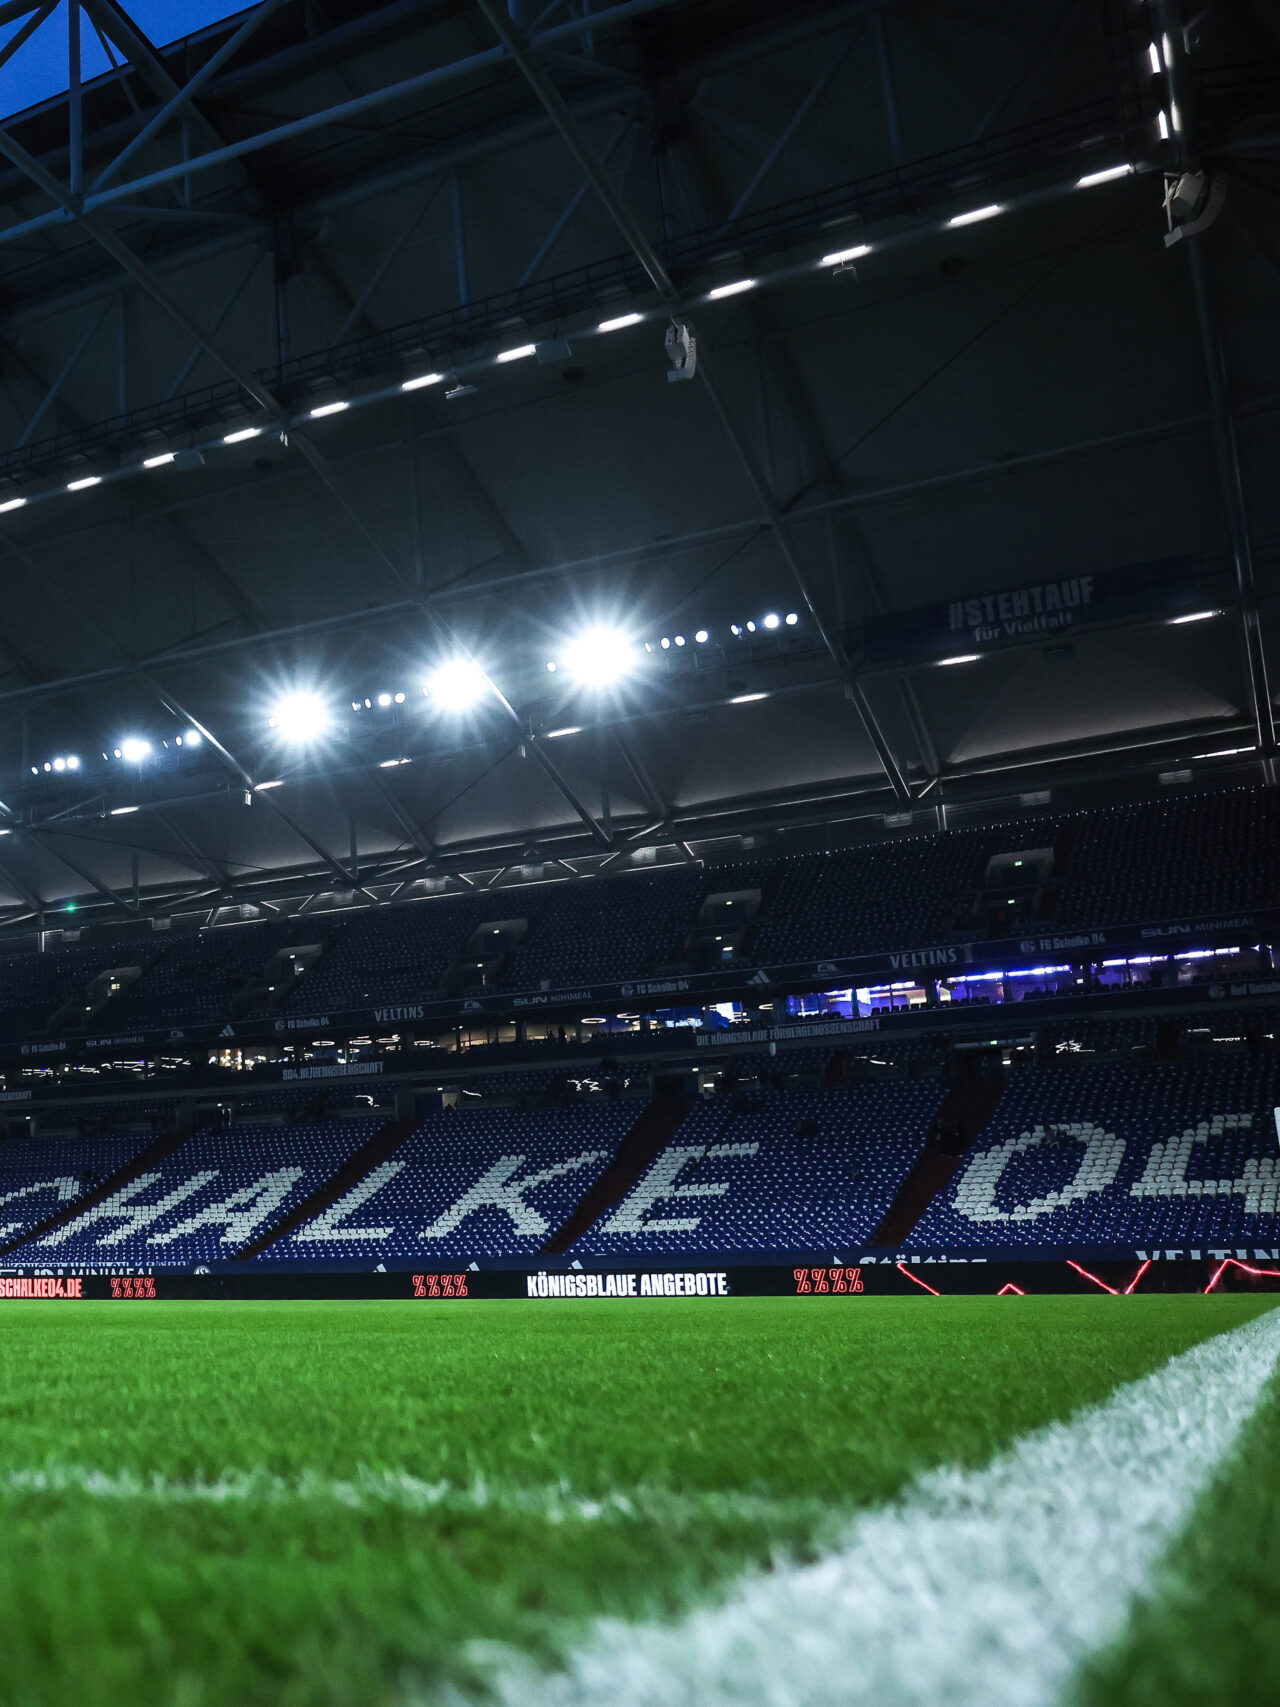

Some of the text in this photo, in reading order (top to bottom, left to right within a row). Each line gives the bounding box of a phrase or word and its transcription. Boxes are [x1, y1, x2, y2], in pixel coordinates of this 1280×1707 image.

[948, 576, 1095, 630] #STEHTAUF
[974, 612, 1073, 642] für Vielfalt
[1141, 917, 1256, 938] SUN MINIMEAL
[1040, 940, 1051, 950] FC
[1092, 933, 1106, 944] 04
[890, 948, 957, 968] VELTINS
[513, 996, 547, 1007] SUN
[550, 991, 592, 1001] MINIMEAL
[374, 1006, 424, 1022] VELTINS
[526, 1271, 728, 1297] KÖNIGSBLAUE ANGEBOTE
